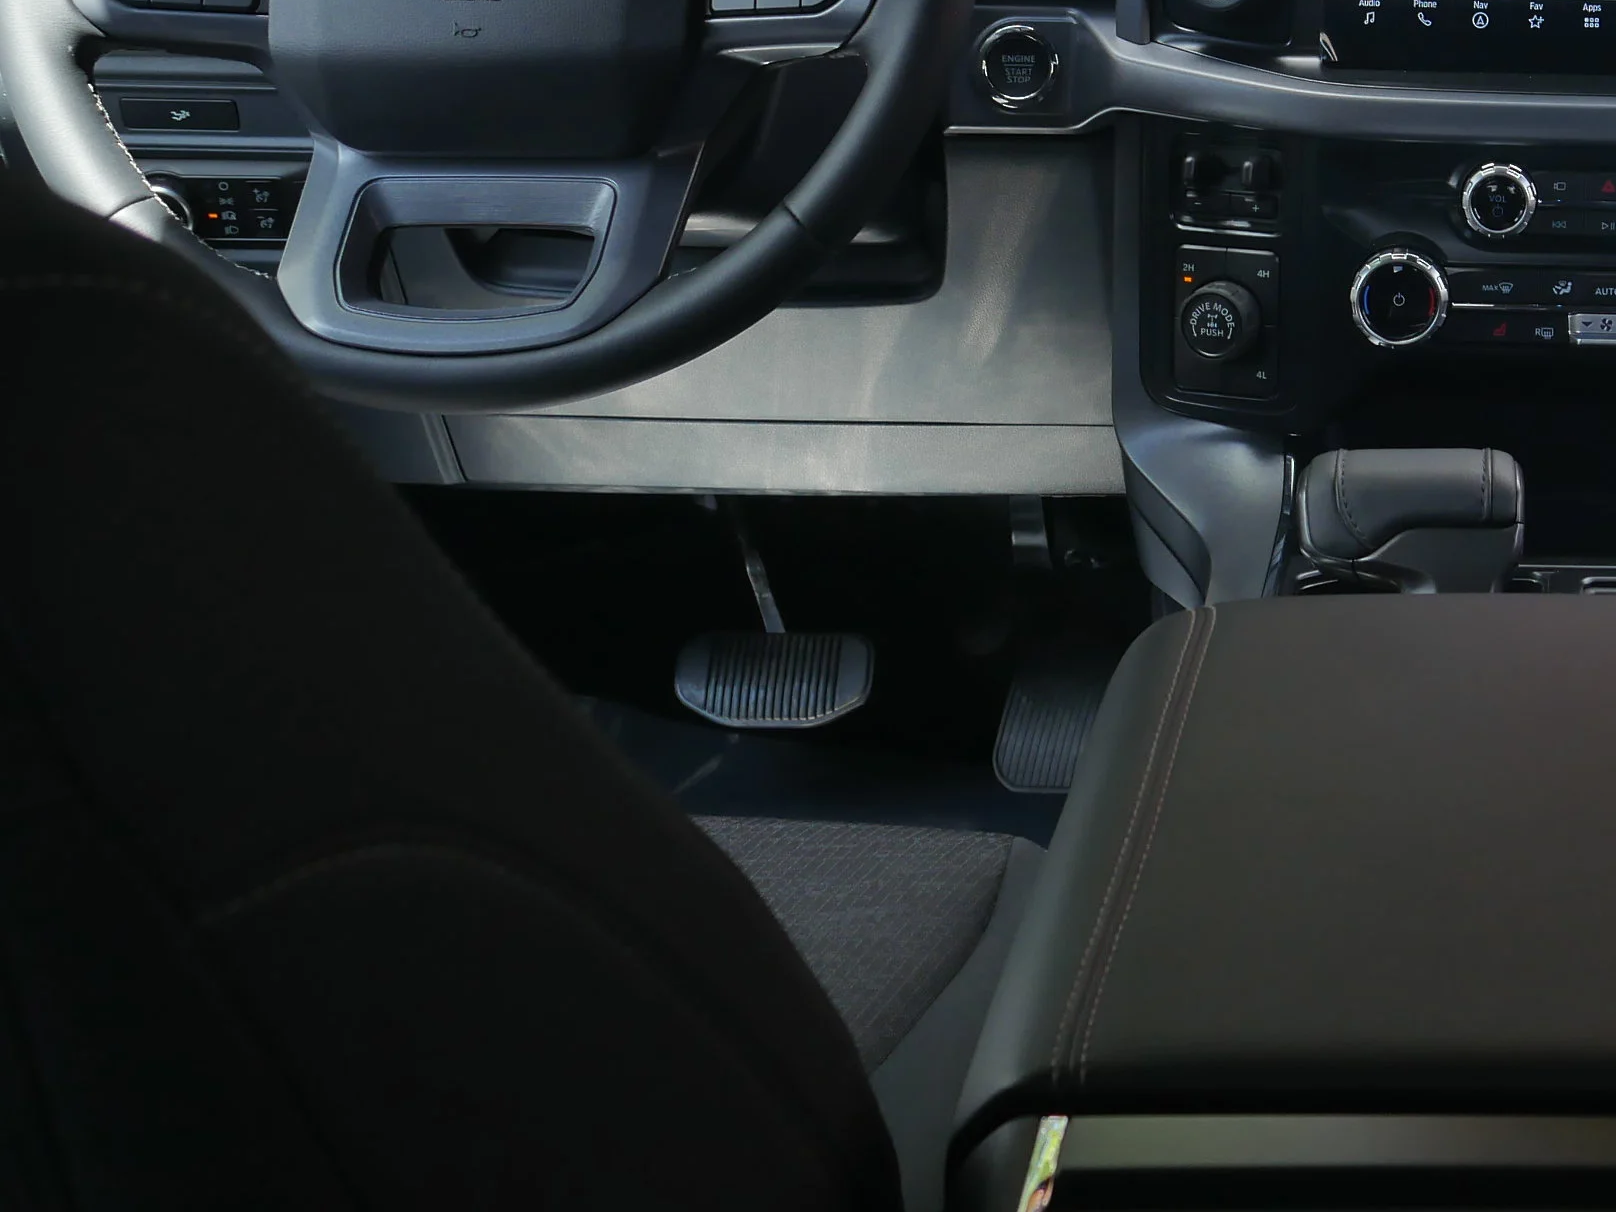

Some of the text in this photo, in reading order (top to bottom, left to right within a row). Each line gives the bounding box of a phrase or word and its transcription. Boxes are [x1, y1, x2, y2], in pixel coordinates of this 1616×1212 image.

[1413, 0, 1437, 8] Phone
[1473, 0, 1489, 10] Nav
[1529, 1, 1544, 10] Fav
[1582, 3, 1602, 12] Apps
[1002, 54, 1036, 63] ENGINE
[1005, 68, 1032, 76] START
[1488, 195, 1506, 203] VOL
[1183, 263, 1195, 272] 2H
[1256, 270, 1270, 278] 4H
[1190, 302, 1236, 328] DRIVE MODE
[1200, 328, 1224, 337] PUSH
[1256, 371, 1267, 380] 4L
